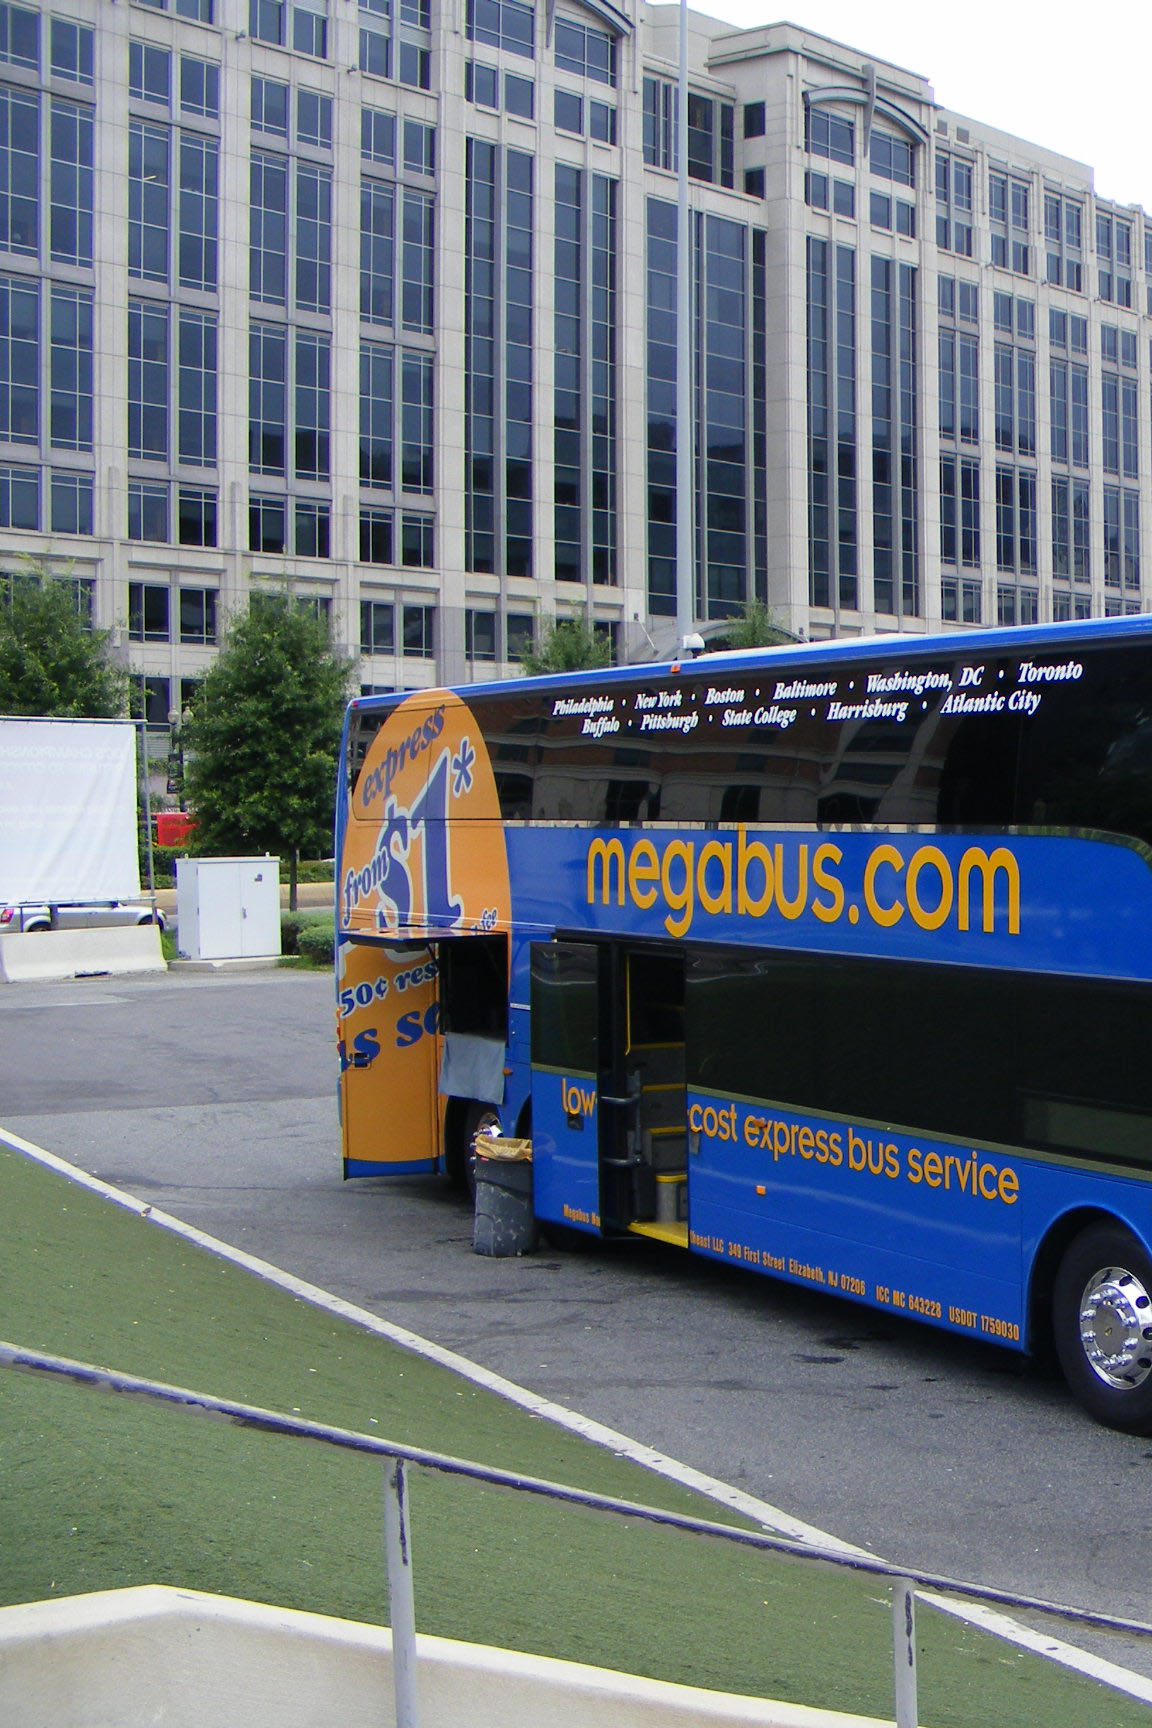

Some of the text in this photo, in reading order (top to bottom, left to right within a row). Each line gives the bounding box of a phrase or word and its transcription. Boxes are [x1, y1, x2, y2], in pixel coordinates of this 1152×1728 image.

[552, 661, 1083, 717] Philadelphia New York Boston Baltimore Washington, DC Toronto
[582, 689, 1041, 738] Buffalo Pittsburgh State College Harrisburg Atlantic City
[362, 704, 446, 806] express
[344, 847, 390, 926] from
[587, 823, 1021, 939] megabus.com
[743, 1114, 844, 1168] express
[848, 1127, 900, 1179] bus
[906, 1150, 1020, 1205] service
[711, 1236, 724, 1254] LLC
[728, 1241, 741, 1259] 349
[743, 1246, 760, 1265] First
[762, 1251, 785, 1272] Street
[788, 1257, 826, 1284] Elizabeth,
[827, 1270, 838, 1288] NJ
[840, 1273, 866, 1296] 07206
[875, 1284, 890, 1303] ICC
[892, 1289, 906, 1308] MC
[907, 1294, 942, 1319] 643228
[948, 1305, 978, 1329] USDOT
[980, 1314, 1020, 1341] 1759030
